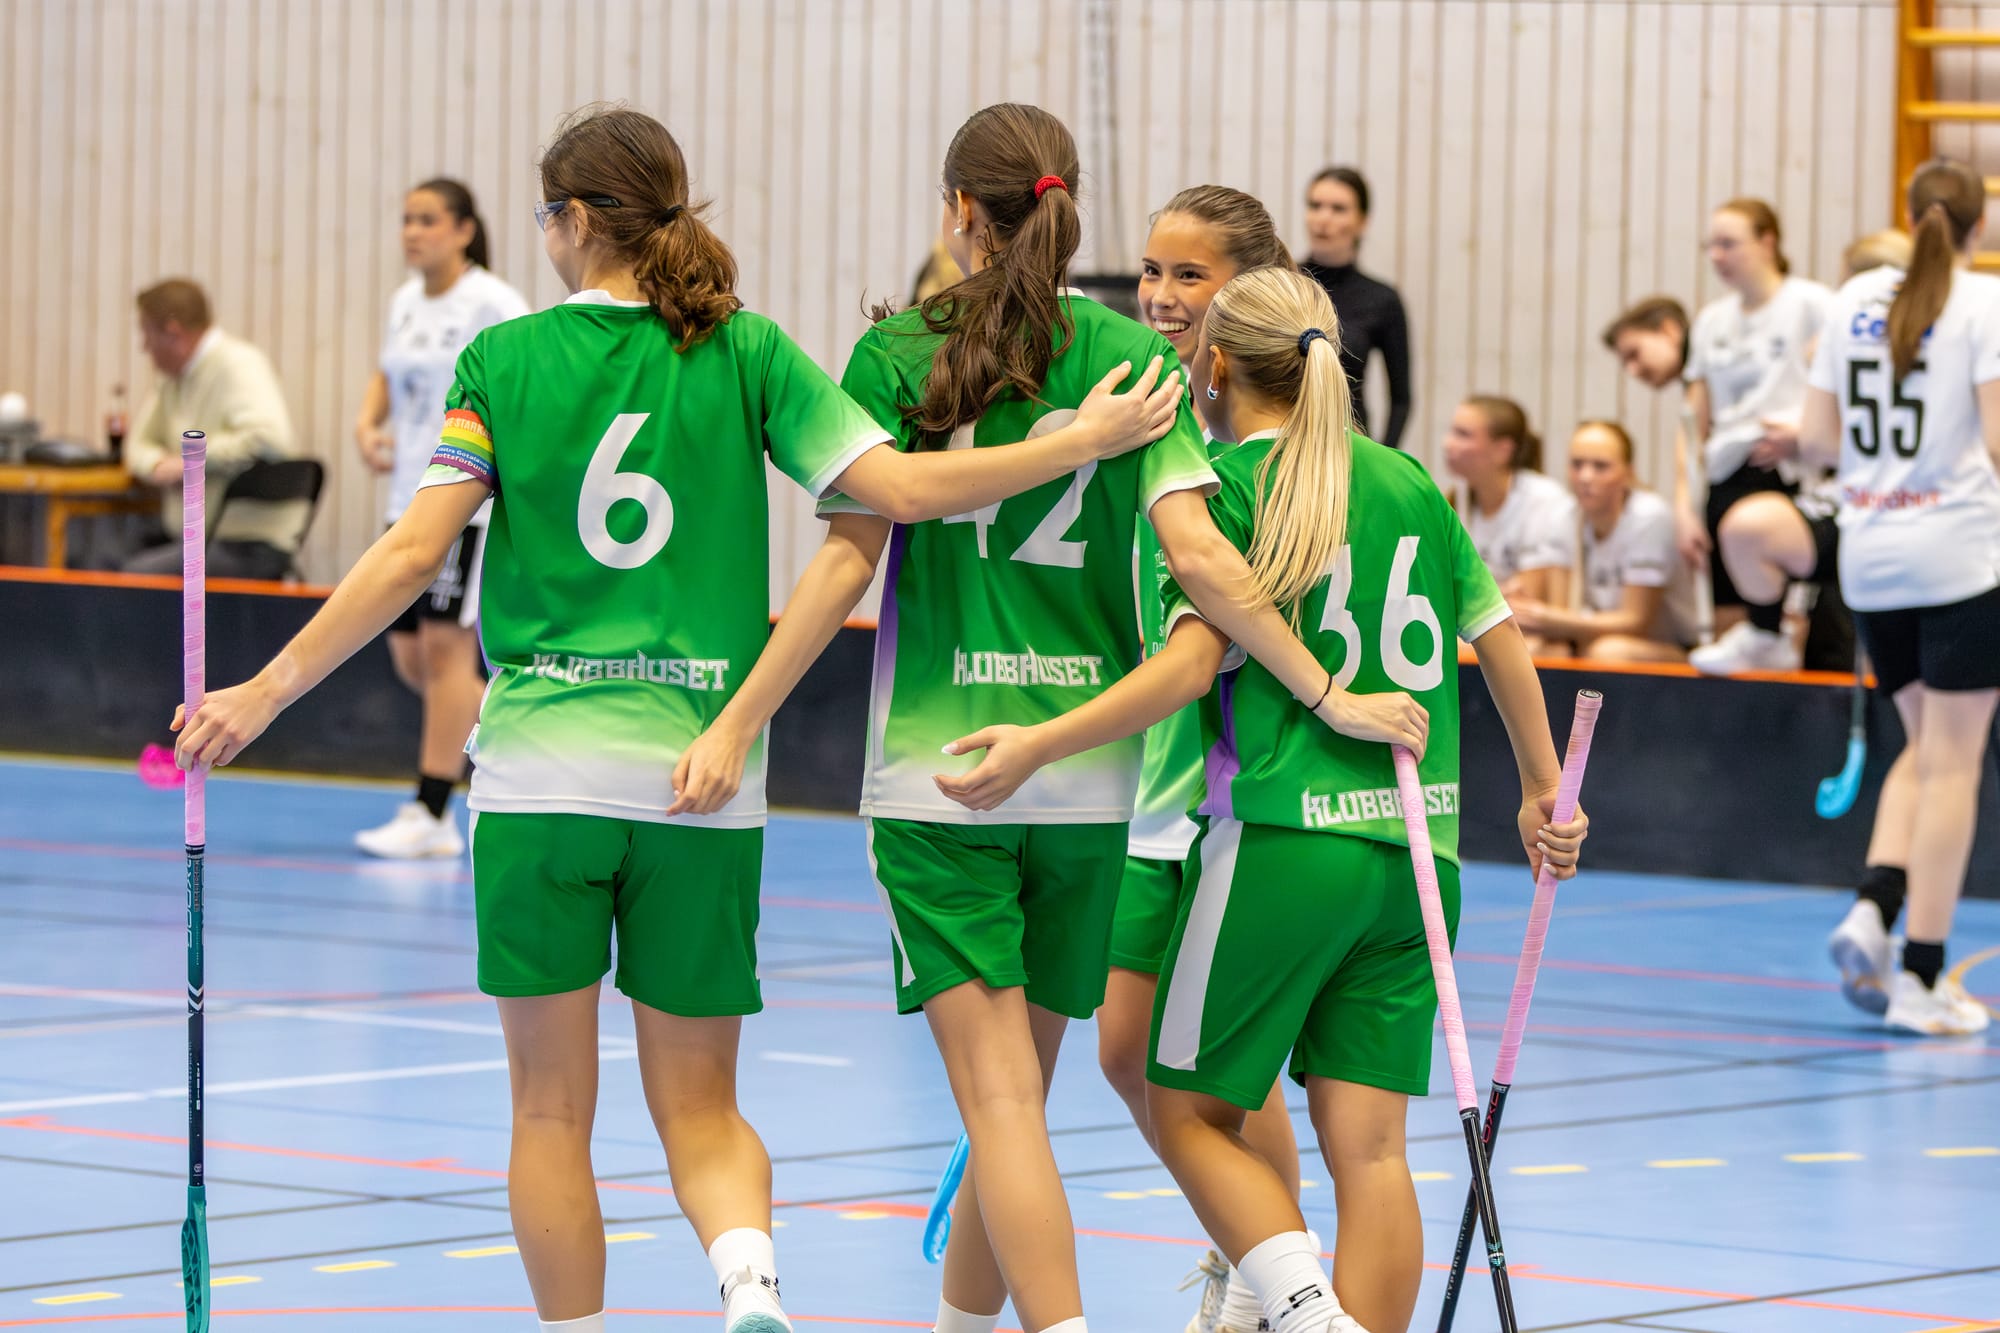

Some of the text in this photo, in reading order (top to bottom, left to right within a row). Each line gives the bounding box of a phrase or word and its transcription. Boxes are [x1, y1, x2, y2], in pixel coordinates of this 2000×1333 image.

[1848, 359, 1926, 458] 55
[577, 412, 674, 570] 6
[1314, 536, 1443, 692] 36
[1301, 782, 1460, 828] KLUBBSE
